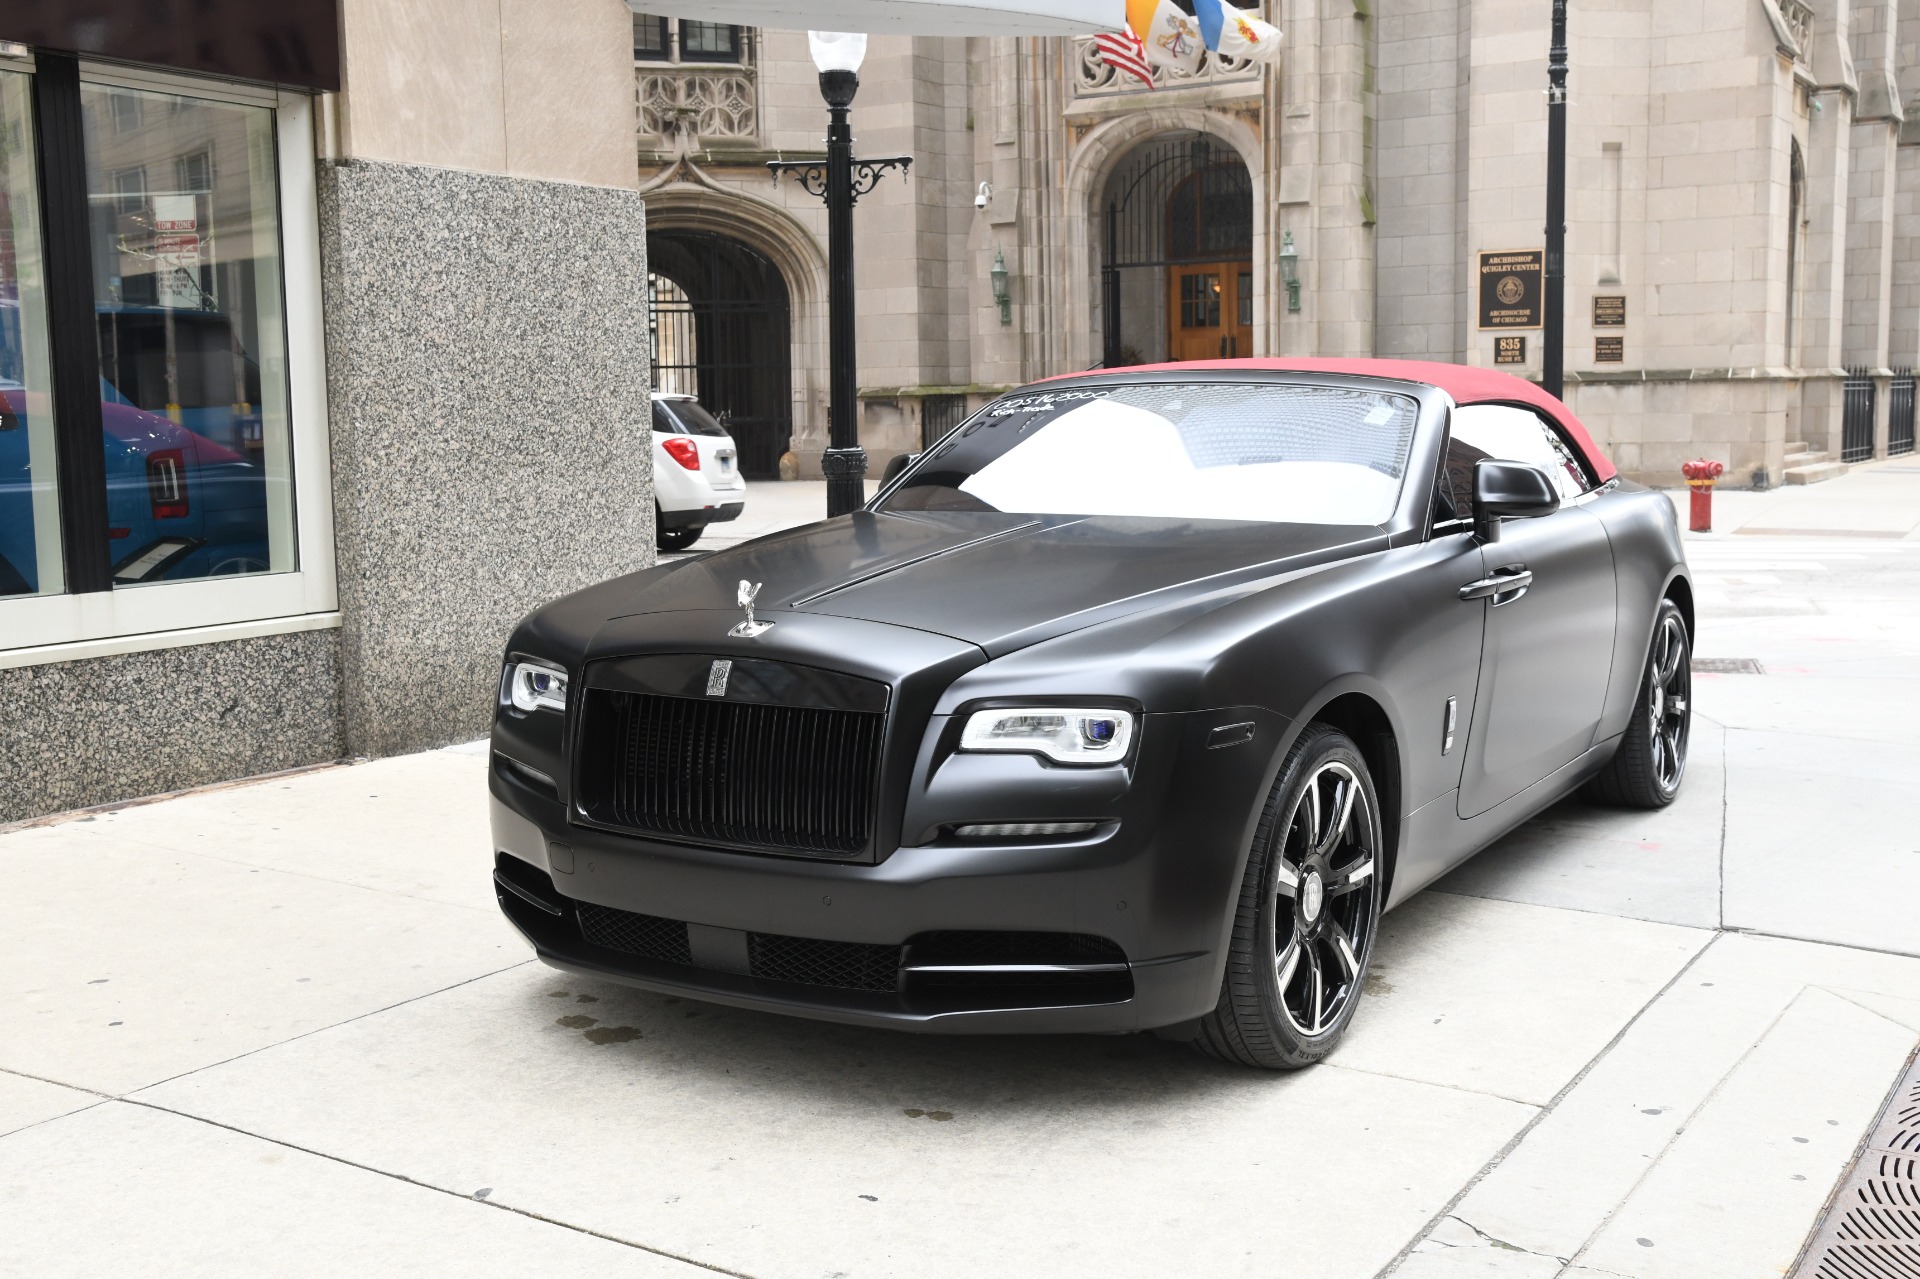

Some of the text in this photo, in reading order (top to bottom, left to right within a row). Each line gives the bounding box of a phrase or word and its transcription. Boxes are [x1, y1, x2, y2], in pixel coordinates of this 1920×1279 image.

[157, 220, 192, 230] TOW ZONE
[1488, 255, 1534, 264] ARCHBISHOP
[1481, 263, 1540, 274] QUIGLEY CENTER
[1489, 308, 1531, 317] ARCHDIOCESE
[1499, 338, 1521, 350] 835
